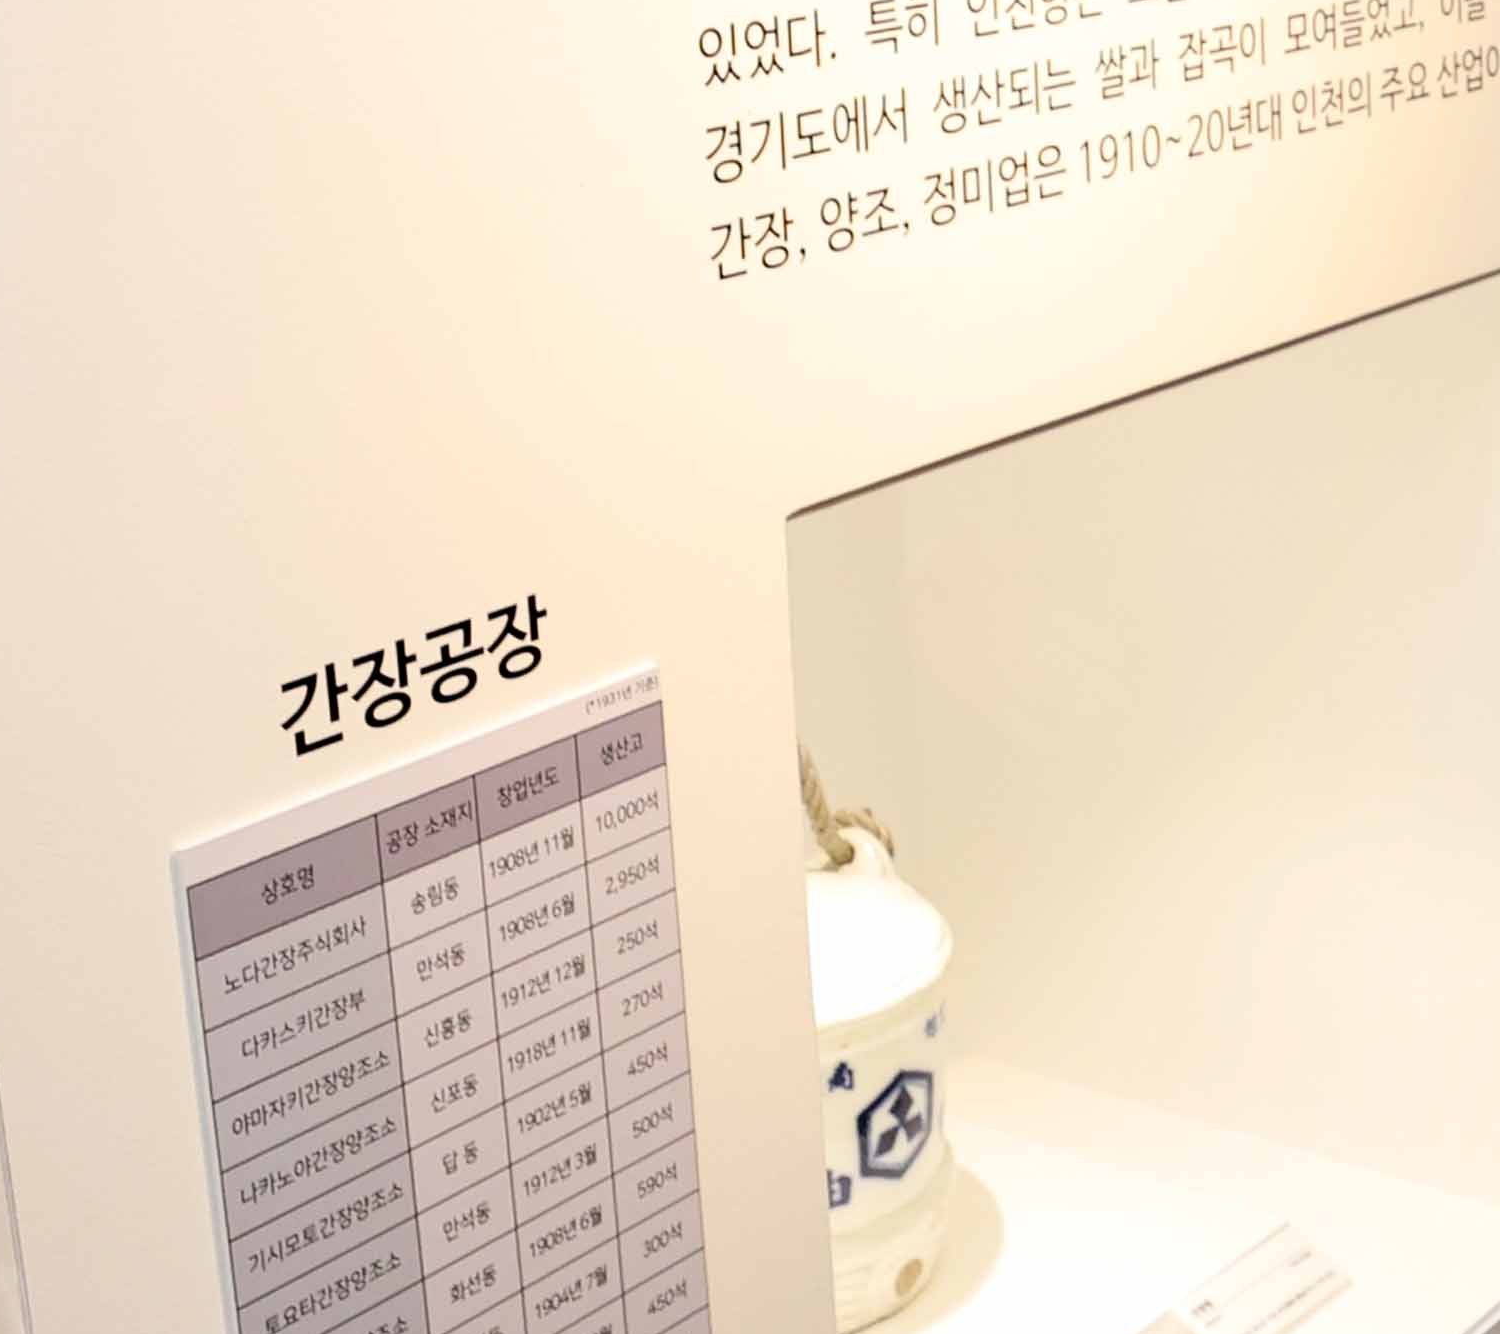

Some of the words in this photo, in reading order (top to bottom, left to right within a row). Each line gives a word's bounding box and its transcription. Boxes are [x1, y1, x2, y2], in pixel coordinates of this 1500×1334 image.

[698, 9, 837, 88] 있었다.
[705, 86, 909, 185] 경기도에서
[932, 58, 1077, 135] 생산되는
[1095, 38, 1161, 101] 쌀과
[1178, 15, 1267, 84] 잡곡이
[710, 206, 807, 281] 간장,
[819, 187, 911, 253] 양조,
[923, 143, 1068, 227] 정미업은
[1079, 91, 1283, 184] 1910~20년대
[1290, 70, 1373, 136] 인천의
[1378, 60, 1431, 113] 주요
[280, 593, 548, 757] 간장공장
